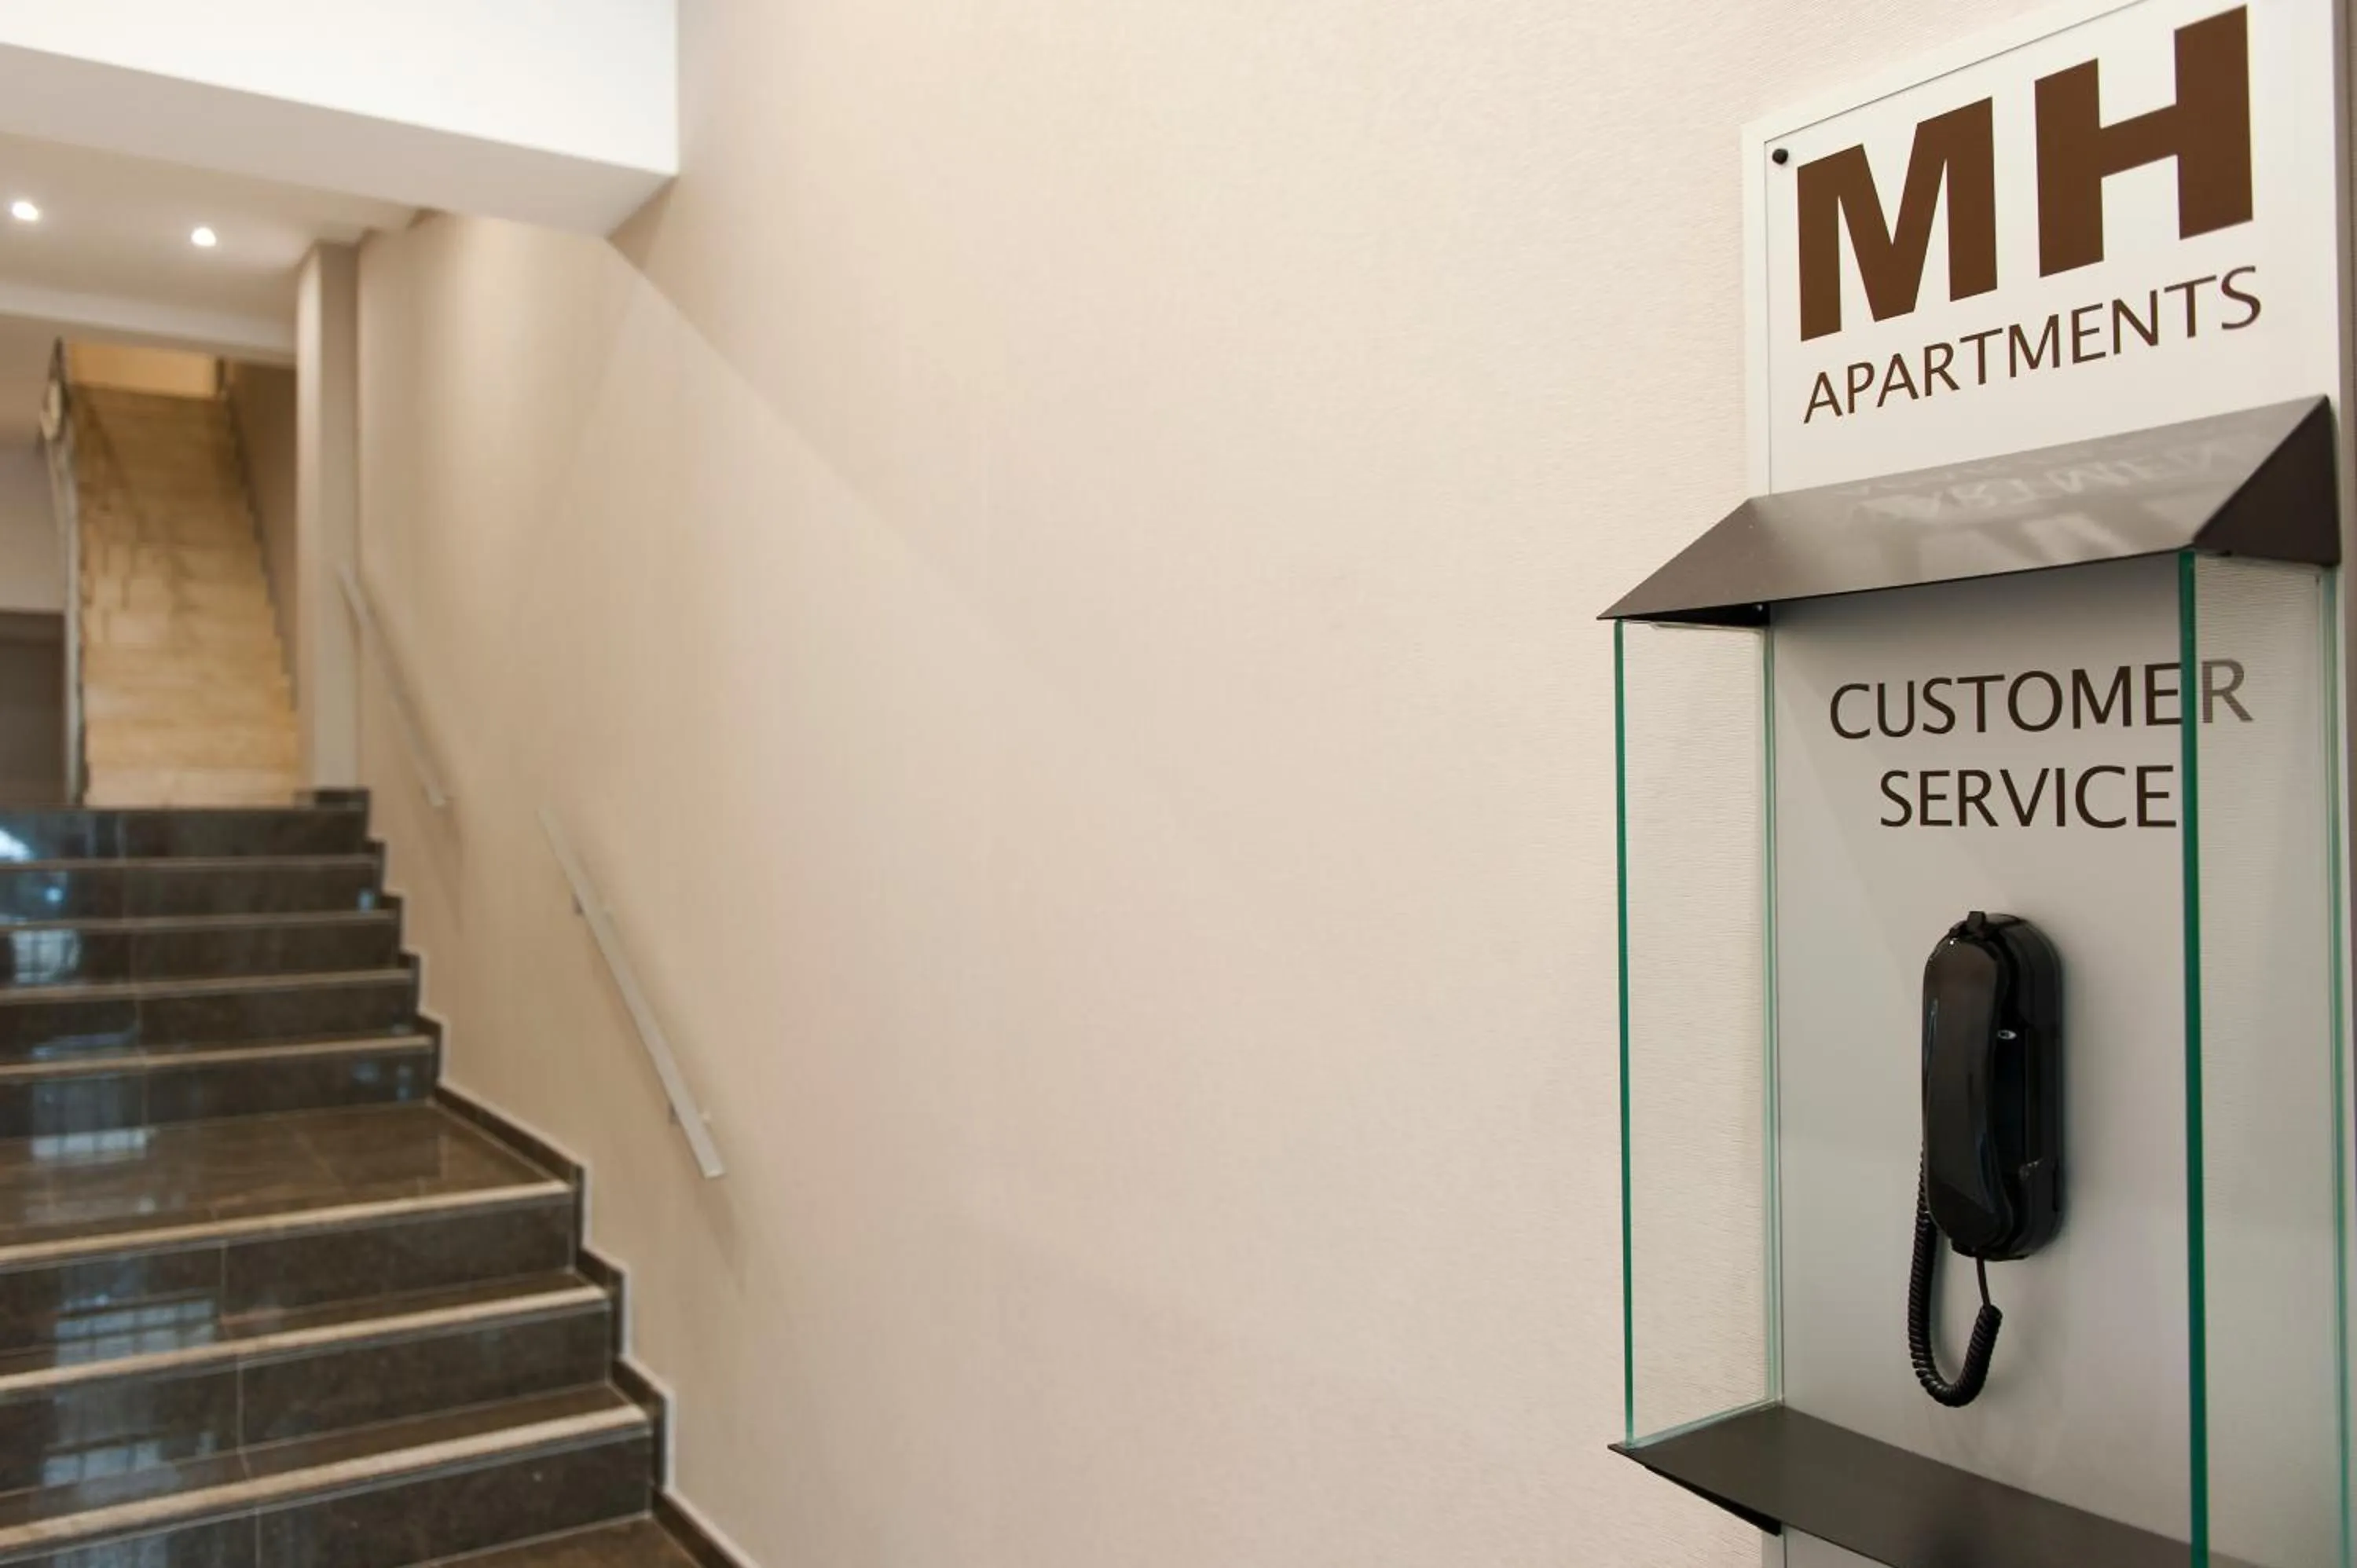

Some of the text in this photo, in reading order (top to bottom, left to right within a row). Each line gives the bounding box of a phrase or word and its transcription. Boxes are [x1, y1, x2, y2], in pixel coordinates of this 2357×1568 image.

[1798, 4, 2253, 343] MH
[1803, 266, 2262, 424] APARTMENTS
[1829, 658, 2254, 739] CUSTOMER
[1879, 764, 2177, 829] SERVICE
